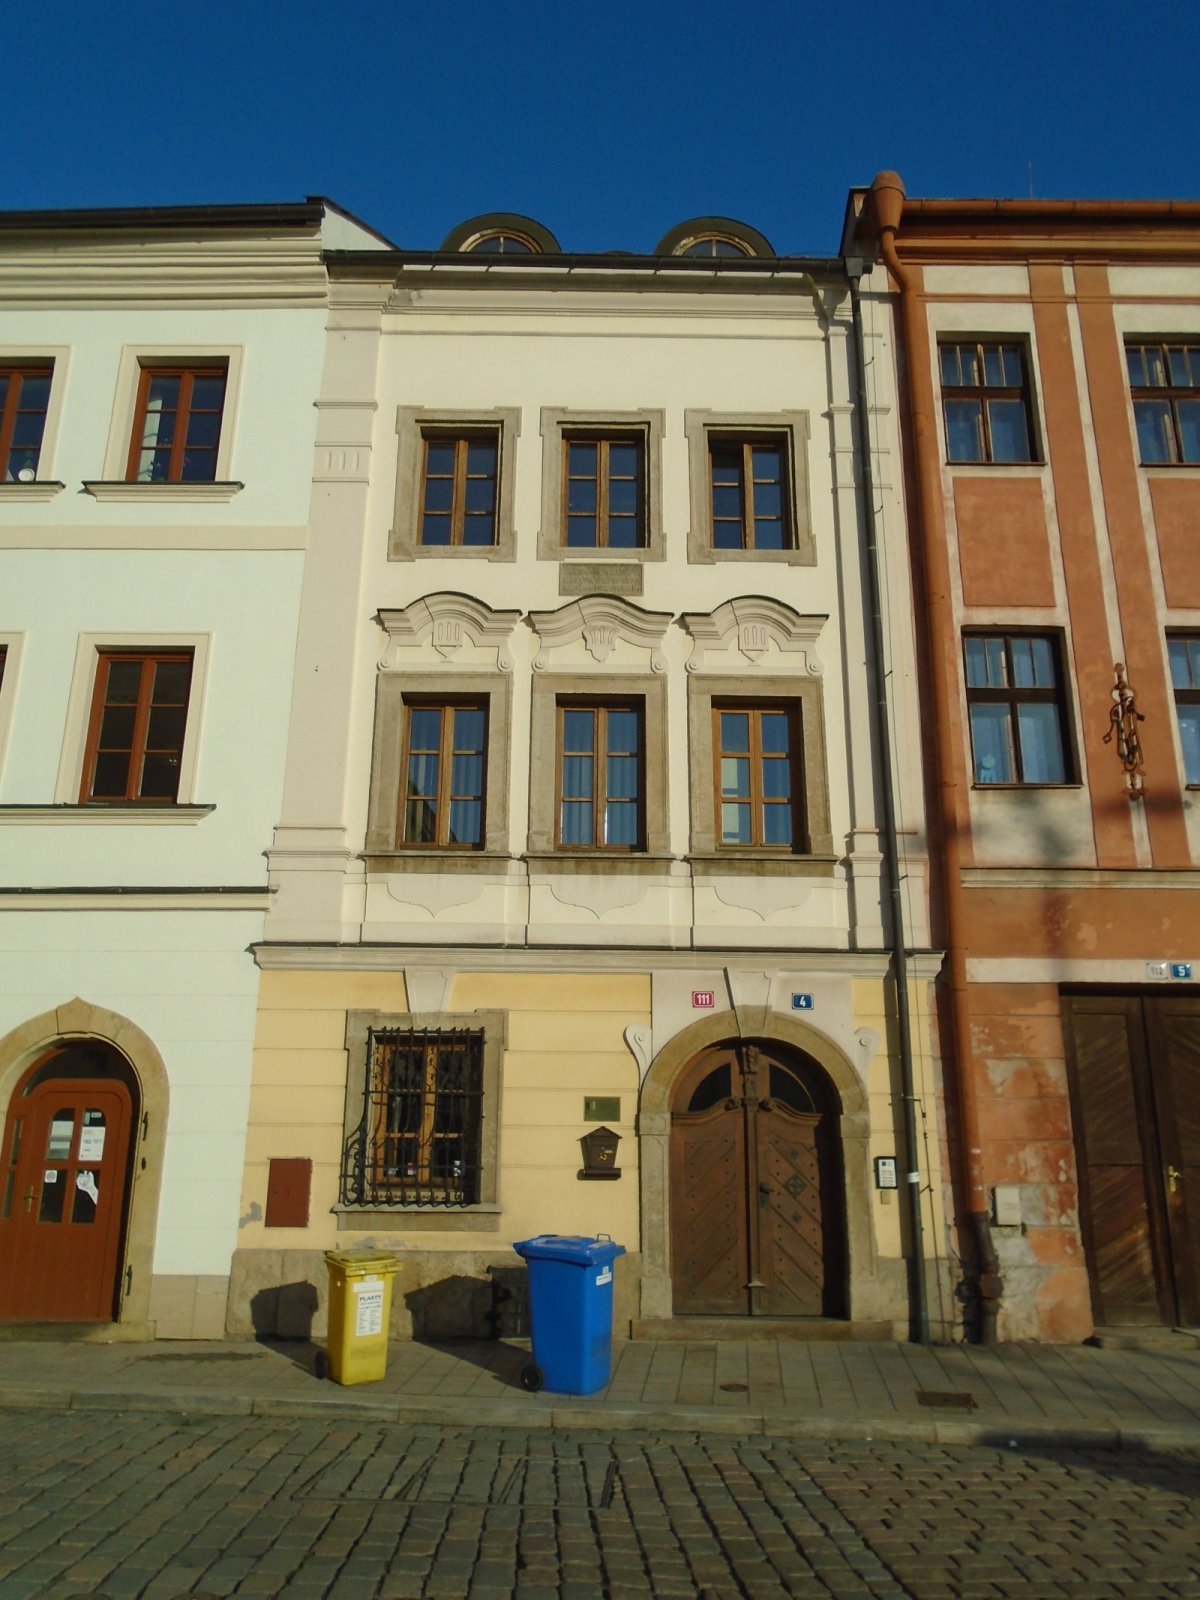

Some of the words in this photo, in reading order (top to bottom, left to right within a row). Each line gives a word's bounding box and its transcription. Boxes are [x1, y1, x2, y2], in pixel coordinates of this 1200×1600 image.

[1178, 965, 1186, 977] 5
[697, 994, 710, 1005] 111
[799, 995, 806, 1008] 4
